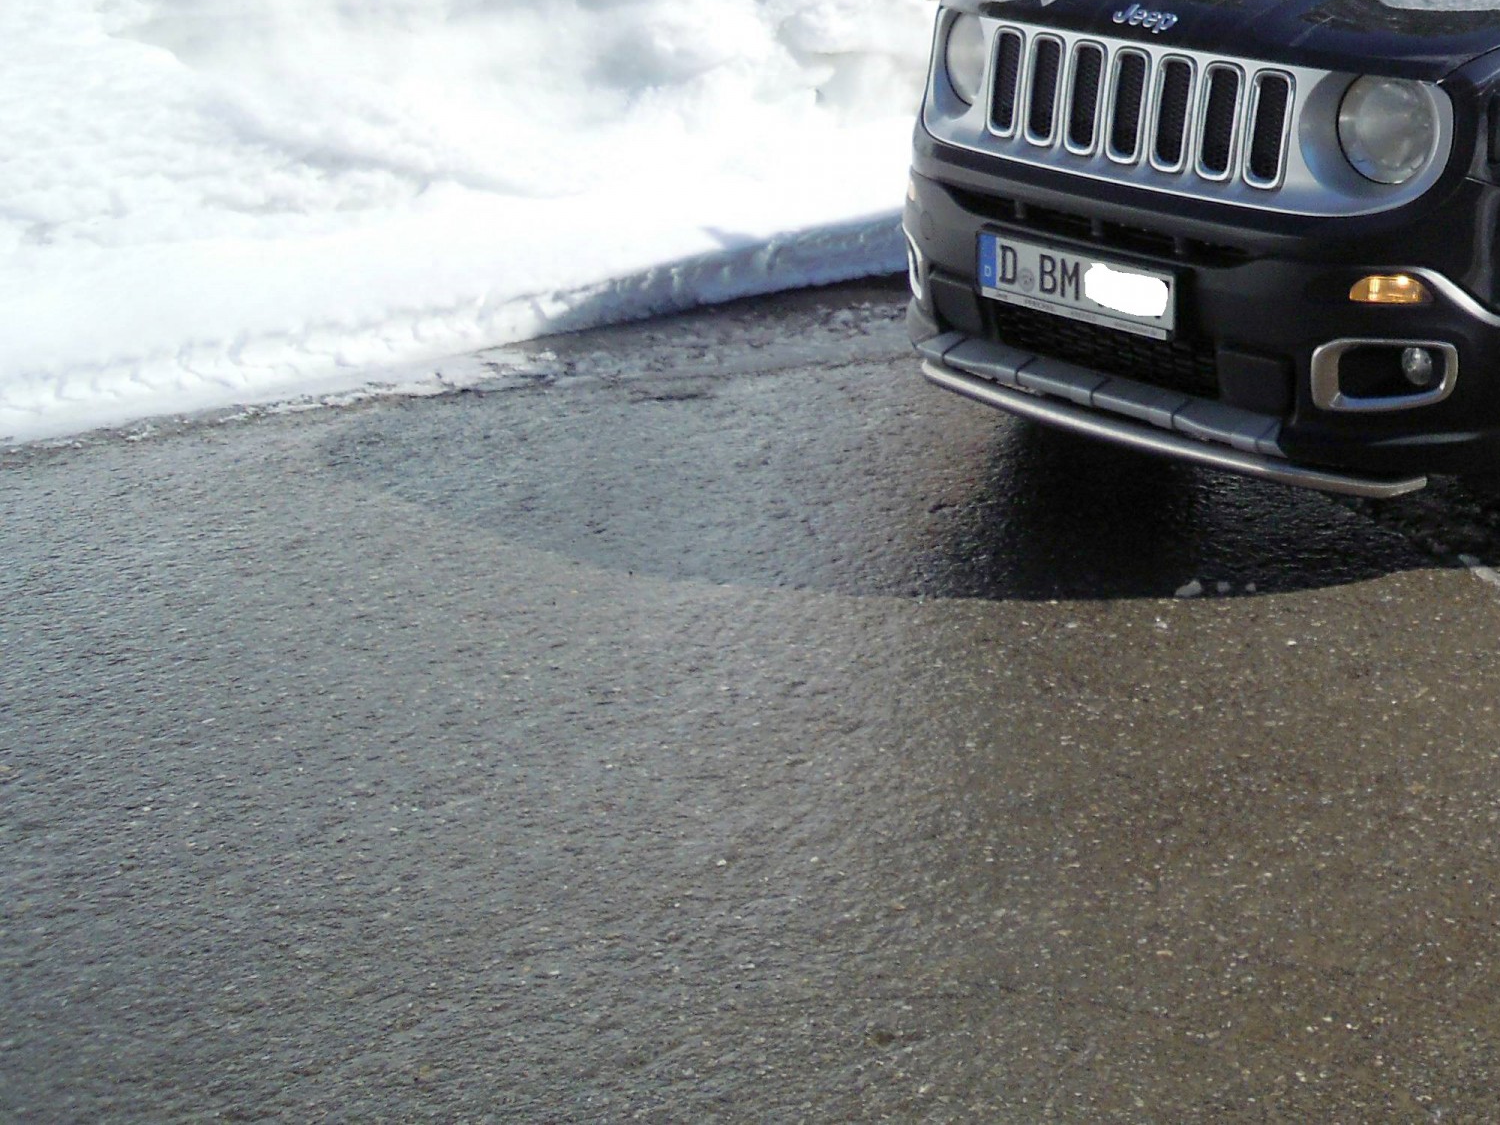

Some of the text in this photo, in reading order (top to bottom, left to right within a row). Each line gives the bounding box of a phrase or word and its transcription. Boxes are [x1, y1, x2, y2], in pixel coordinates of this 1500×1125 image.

[1112, 3, 1178, 34] Jeep
[999, 244, 1018, 285] D
[1039, 253, 1081, 301] BM
